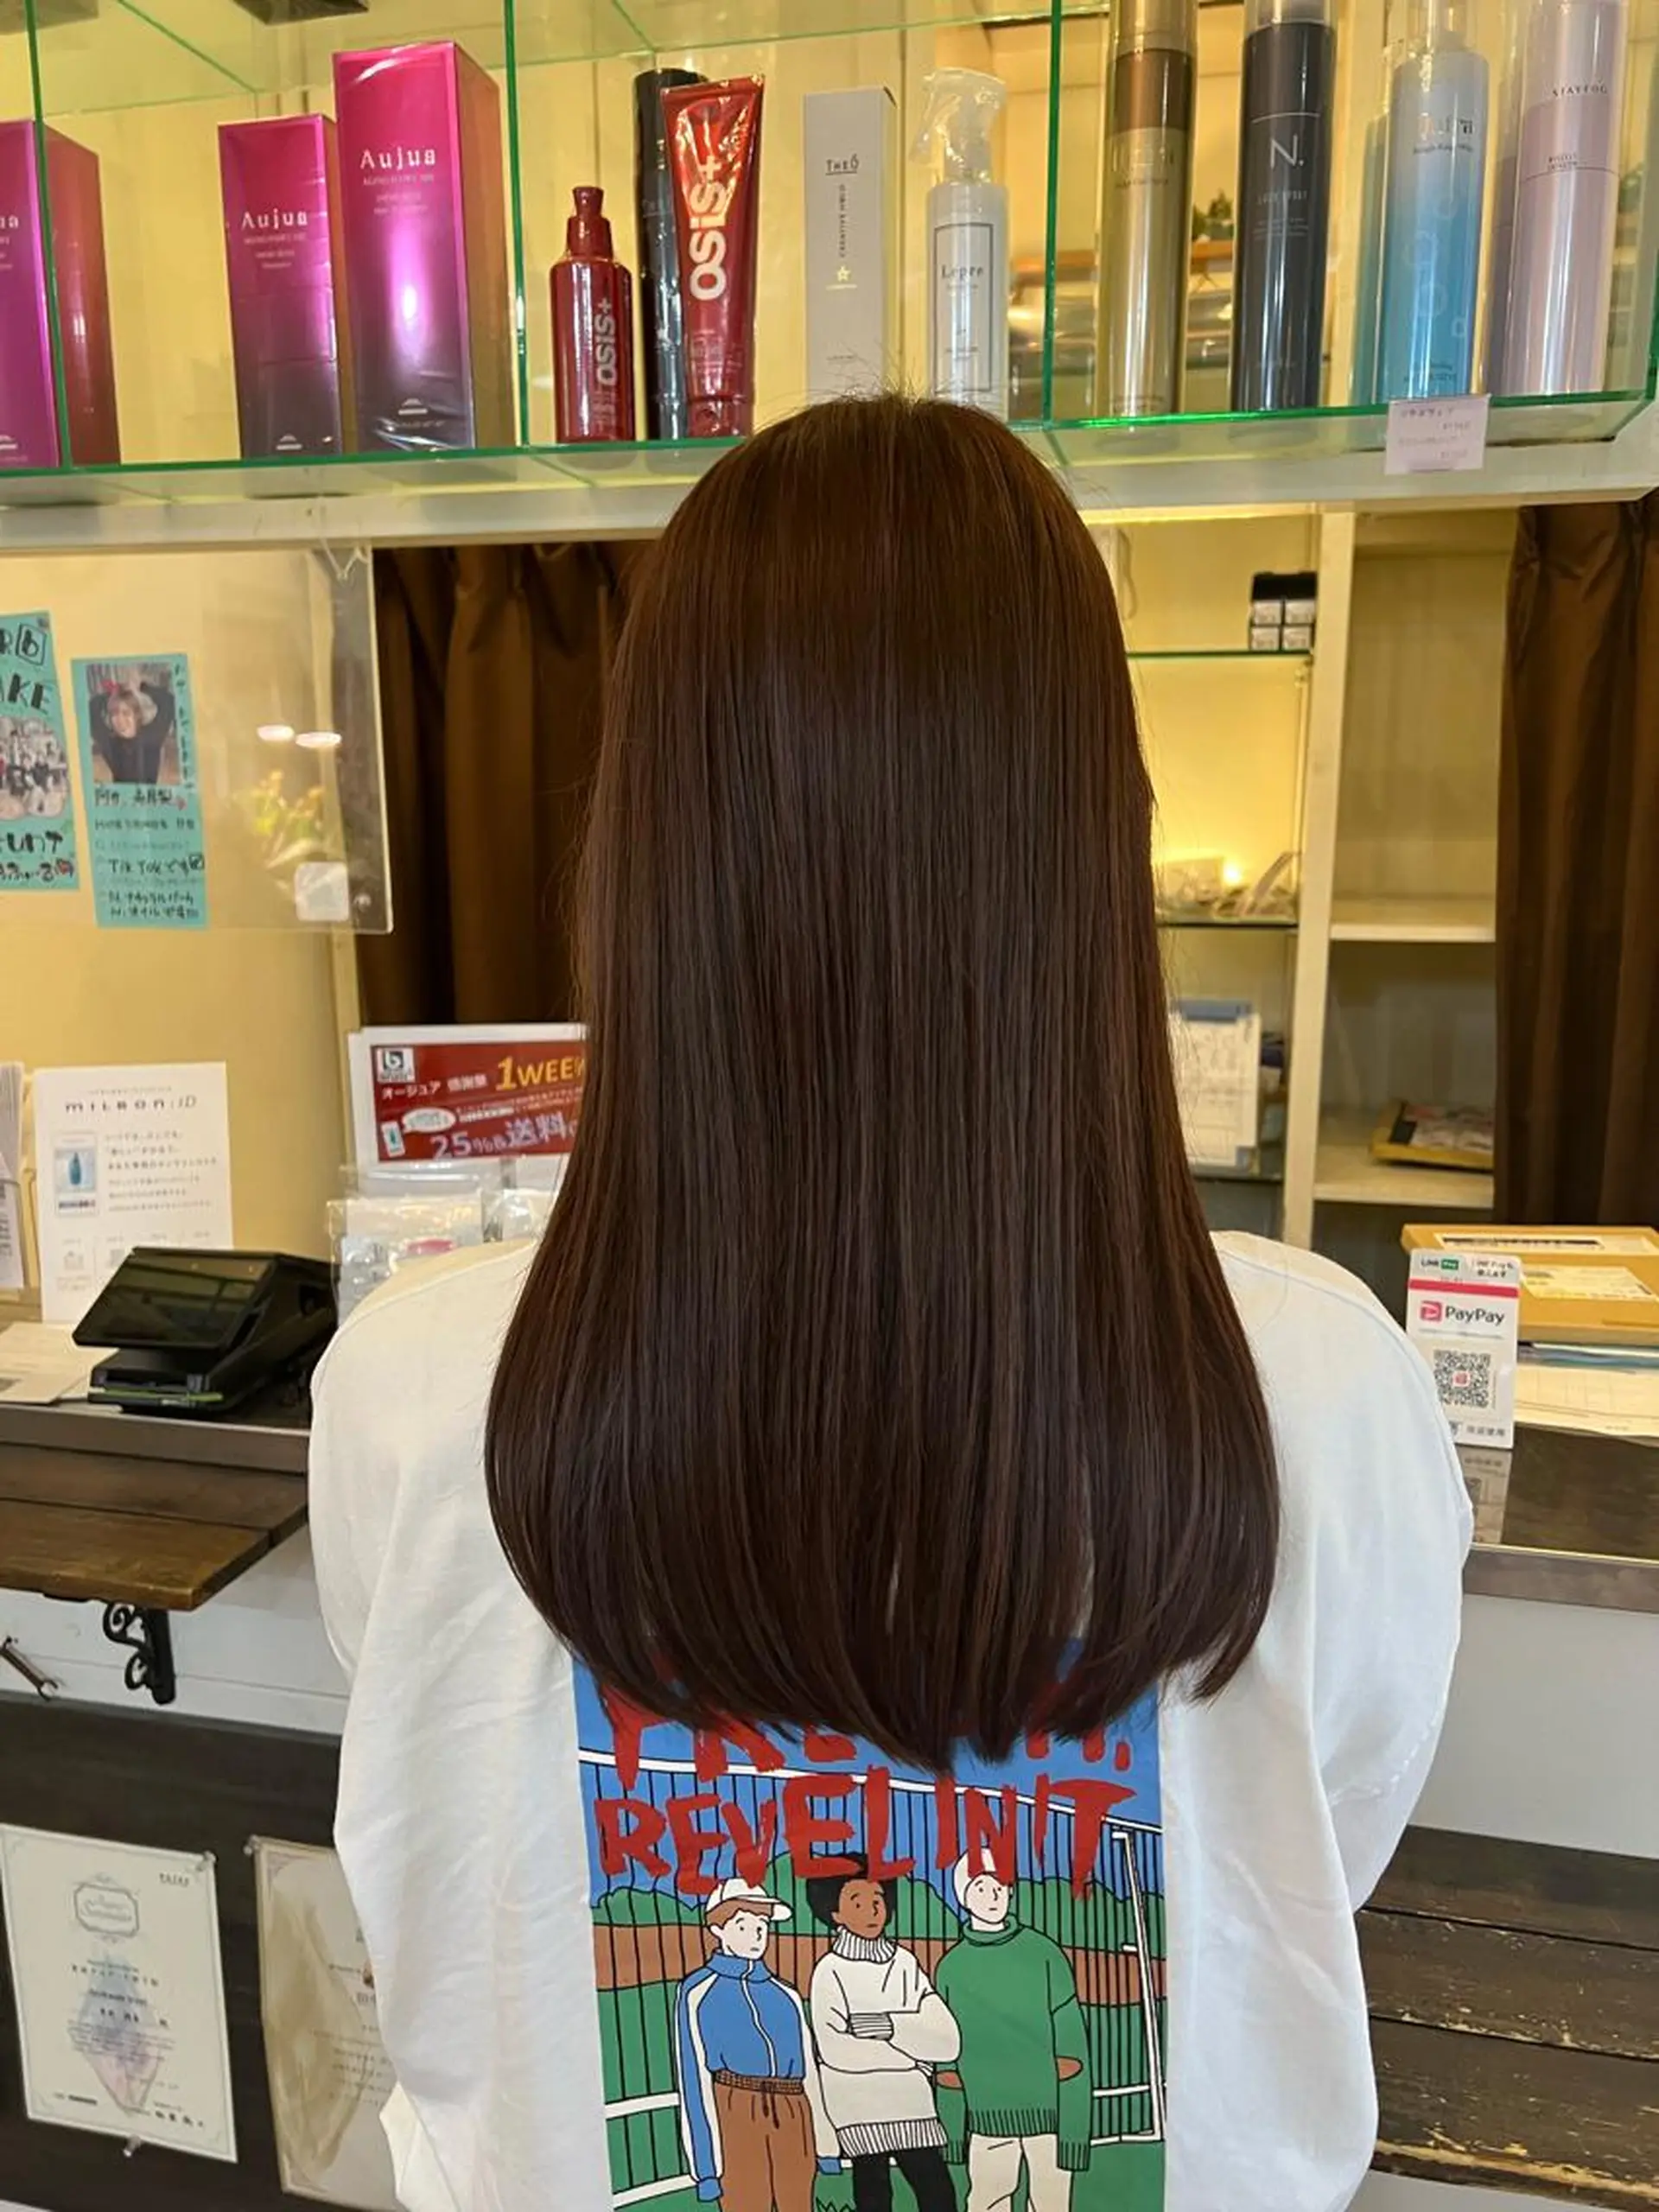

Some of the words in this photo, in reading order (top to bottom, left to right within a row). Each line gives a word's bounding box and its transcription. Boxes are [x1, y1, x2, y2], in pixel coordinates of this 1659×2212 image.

[359, 146, 435, 171] Aujua
[241, 208, 308, 231] Aujua
[1446, 1306, 1505, 1326] PayPay
